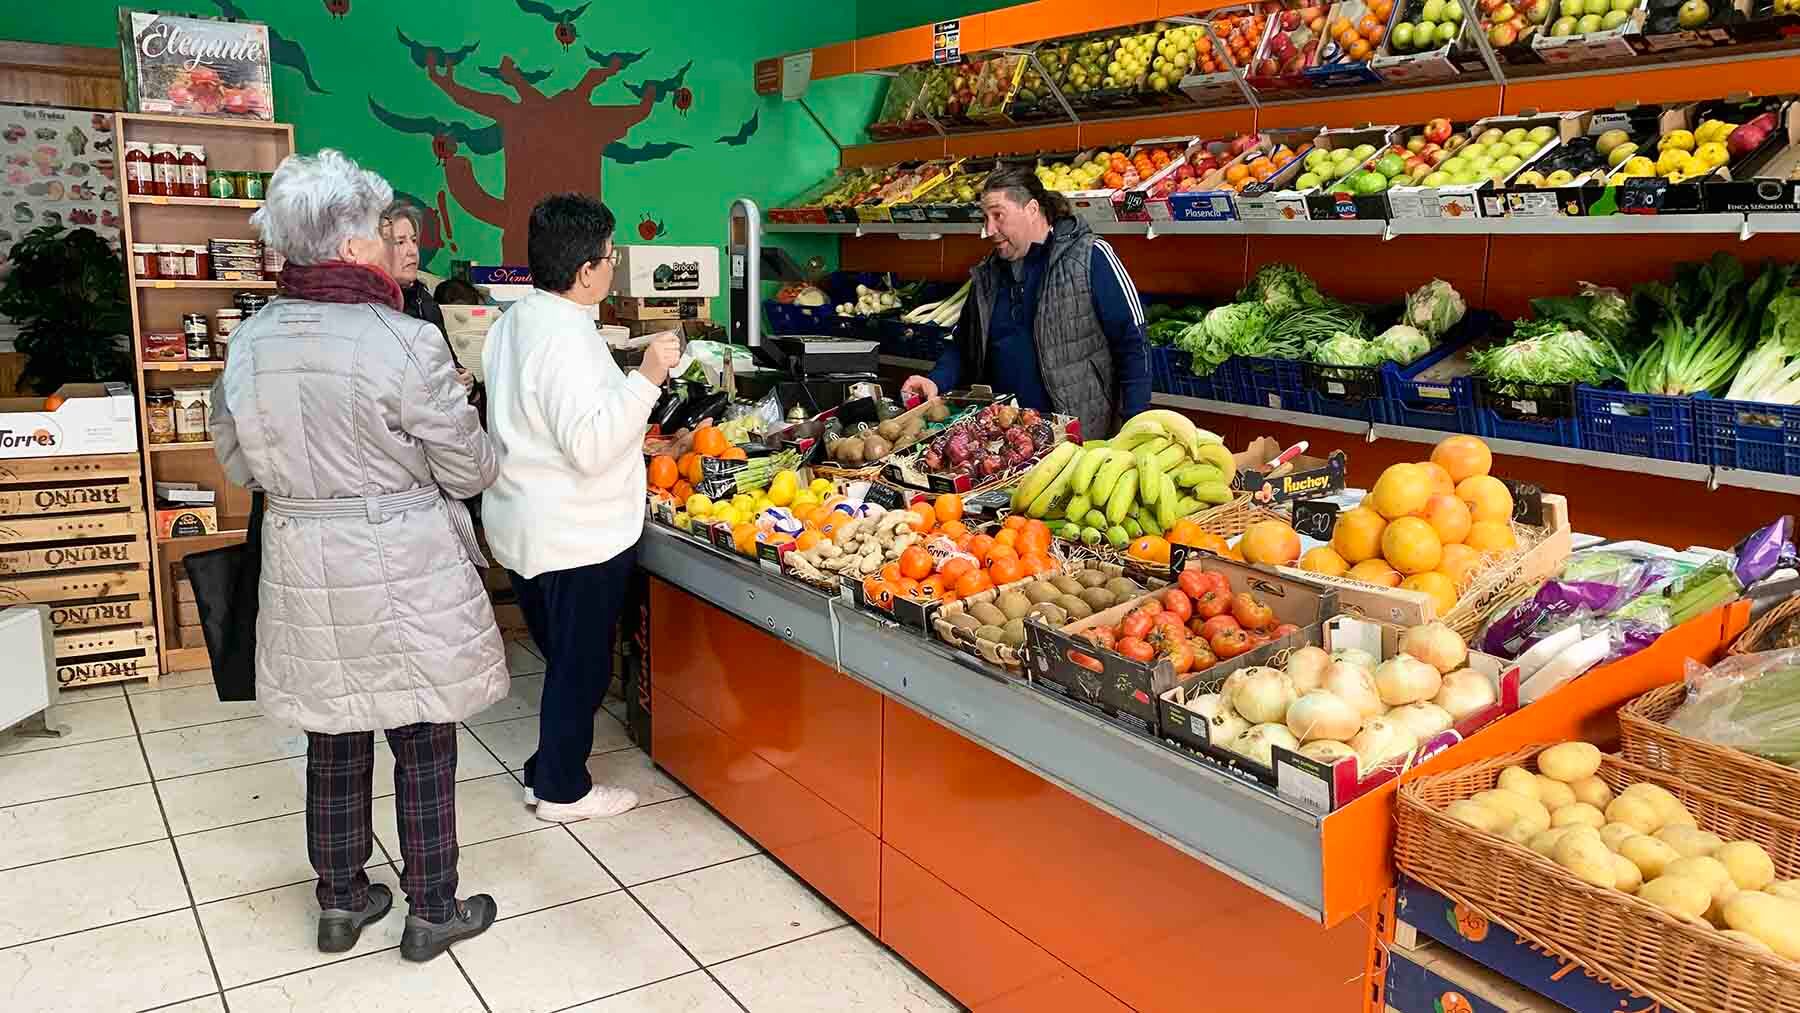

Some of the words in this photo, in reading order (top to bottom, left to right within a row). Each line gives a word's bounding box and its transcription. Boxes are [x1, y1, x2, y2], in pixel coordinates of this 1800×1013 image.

[142, 24, 262, 71] Elegante
[1185, 208, 1222, 218] Plasencia
[0, 430, 56, 448] Torres
[1283, 475, 1329, 493] Ruchey
